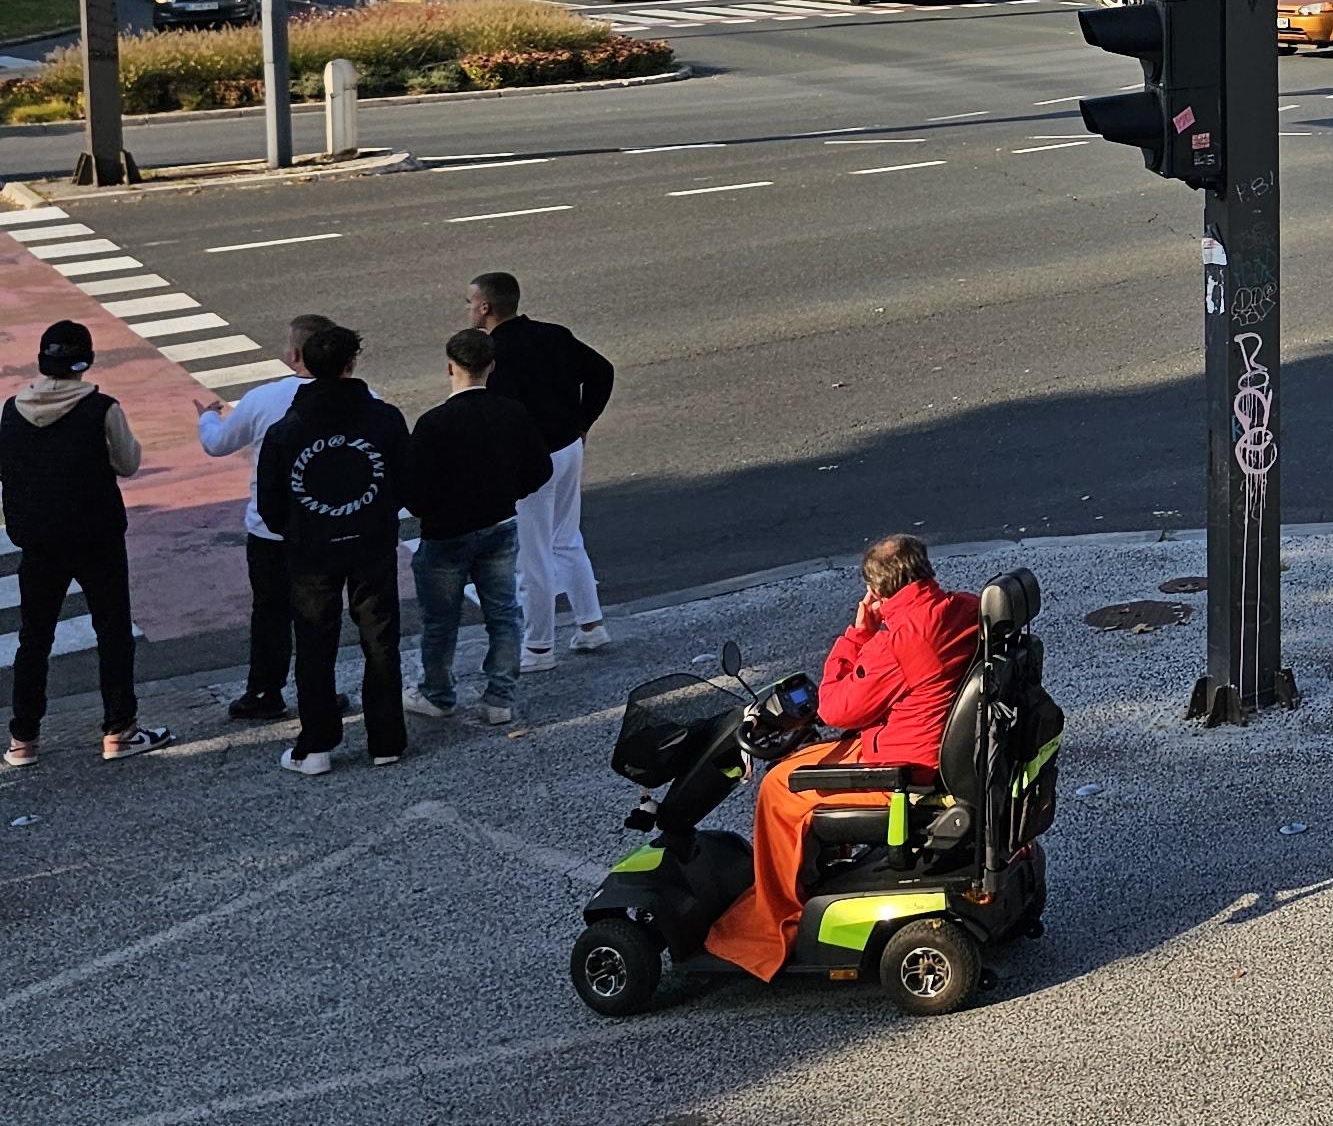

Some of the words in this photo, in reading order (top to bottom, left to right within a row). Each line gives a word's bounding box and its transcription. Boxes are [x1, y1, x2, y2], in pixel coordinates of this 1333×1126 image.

[291, 439, 325, 493] RETRO
[346, 438, 385, 479] JEANS
[296, 483, 379, 516] COMPANY
